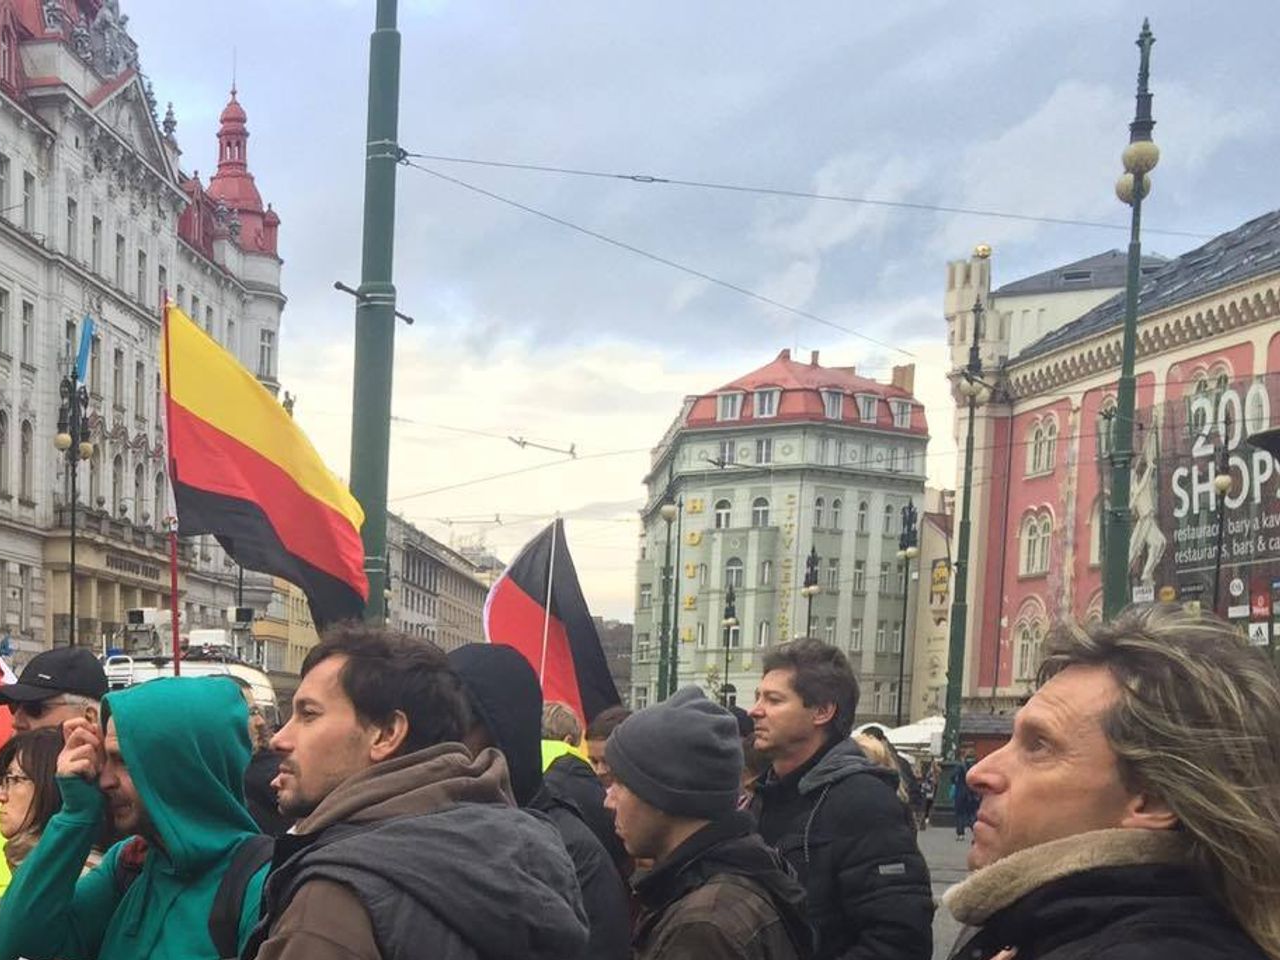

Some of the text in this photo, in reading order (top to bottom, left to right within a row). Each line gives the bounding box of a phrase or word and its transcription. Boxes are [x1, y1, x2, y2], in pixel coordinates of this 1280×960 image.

[1191, 382, 1270, 458] 200
[683, 499, 704, 642] HOTEL
[1232, 537, 1254, 556] bars
